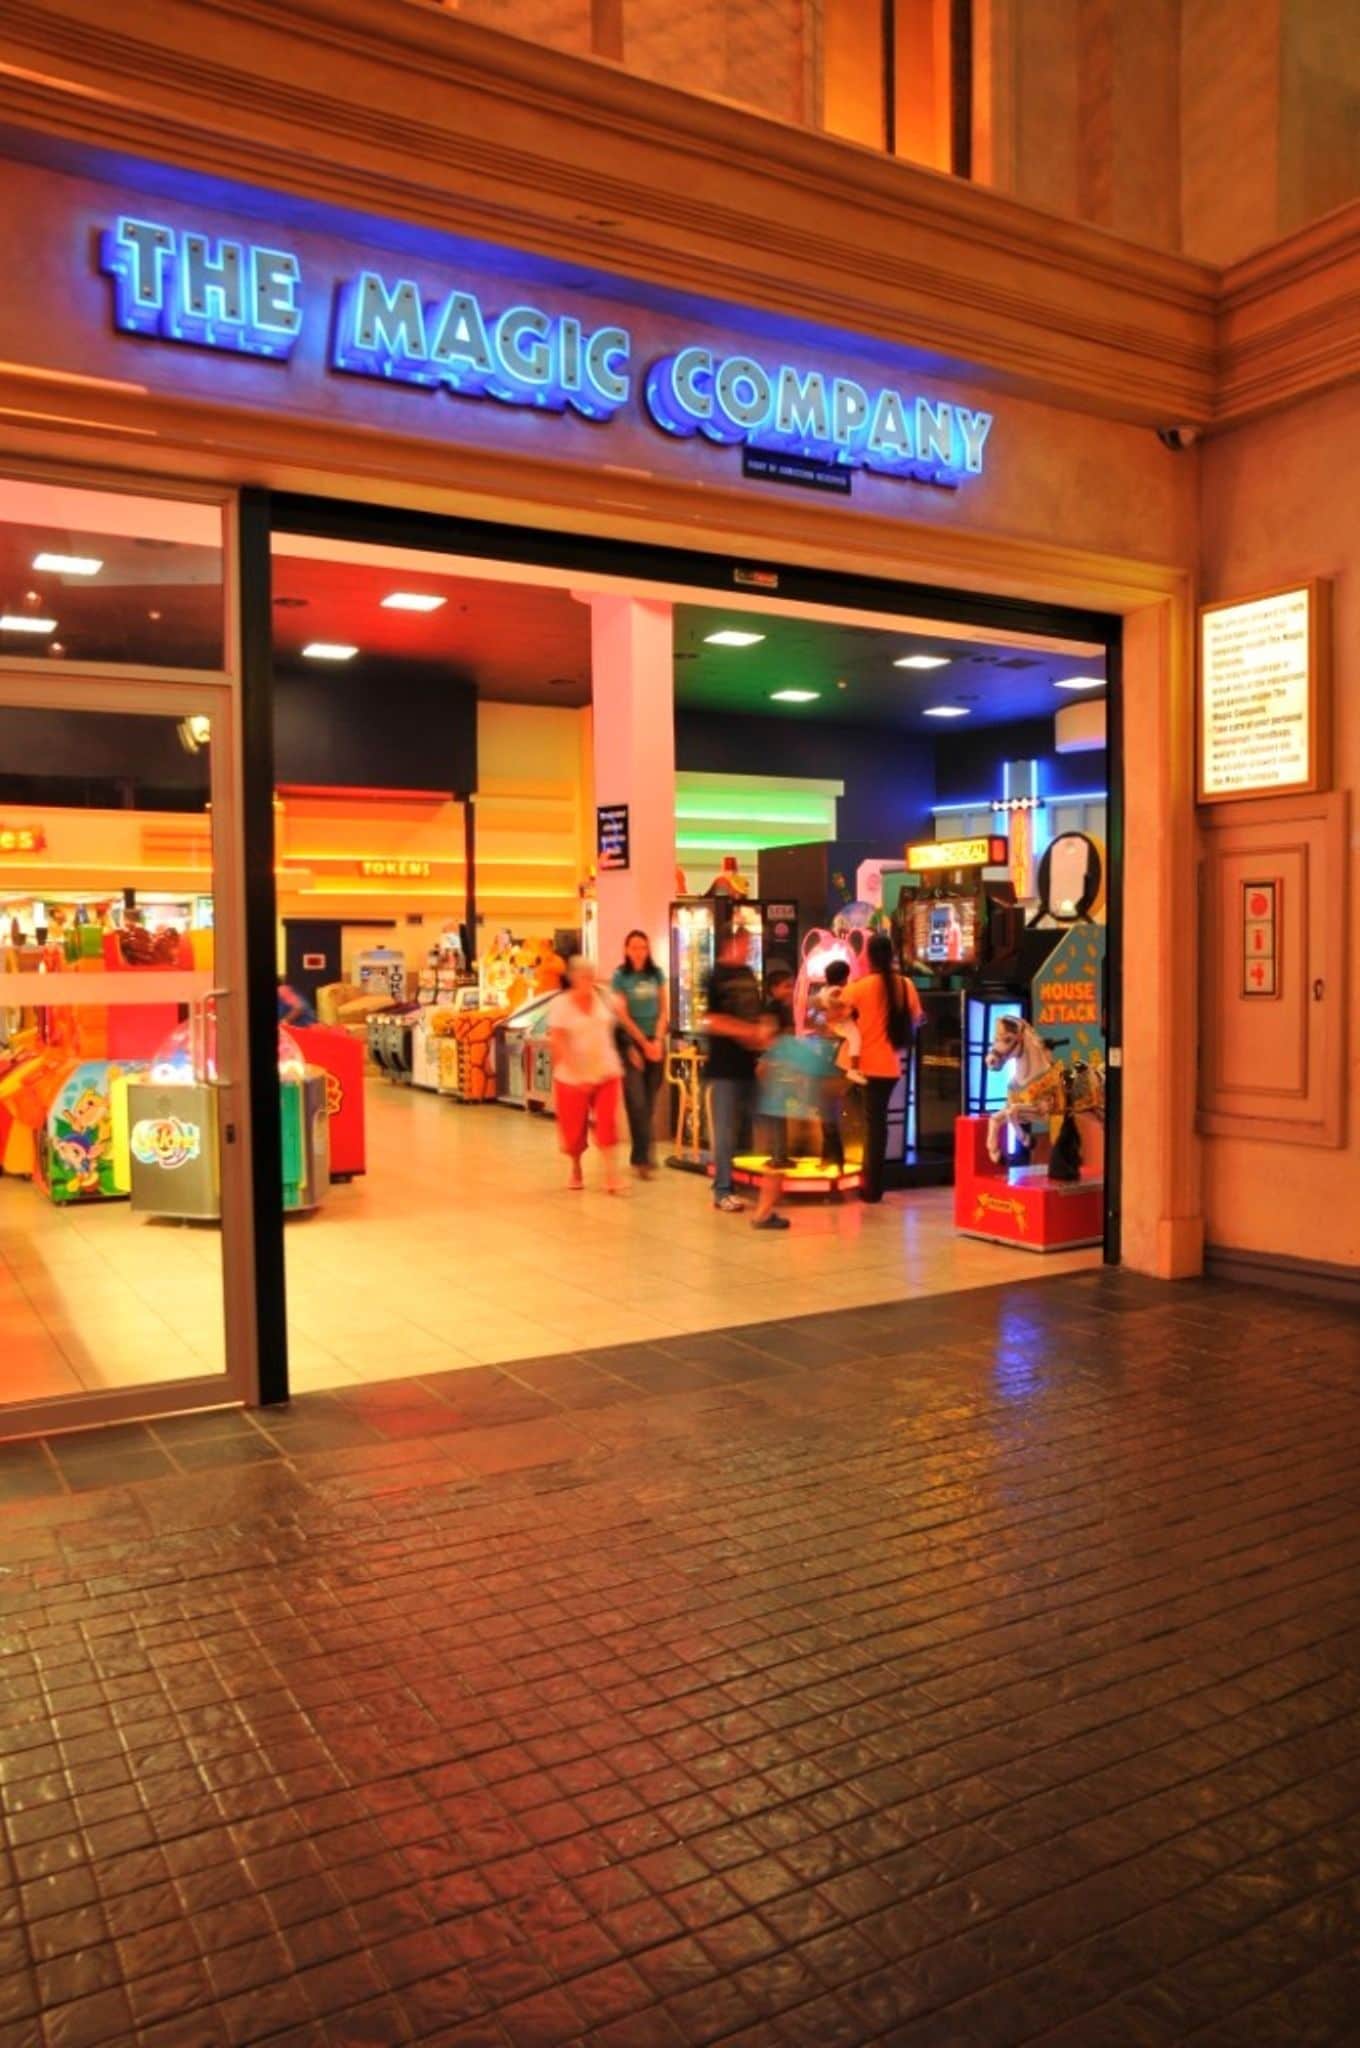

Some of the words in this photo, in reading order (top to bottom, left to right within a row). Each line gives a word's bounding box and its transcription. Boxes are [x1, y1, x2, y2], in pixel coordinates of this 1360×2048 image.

[115, 215, 302, 335] THE
[353, 271, 631, 402] MAGIC
[671, 346, 994, 474] COMPANY
[1039, 1003, 1097, 1024] ATTACK
